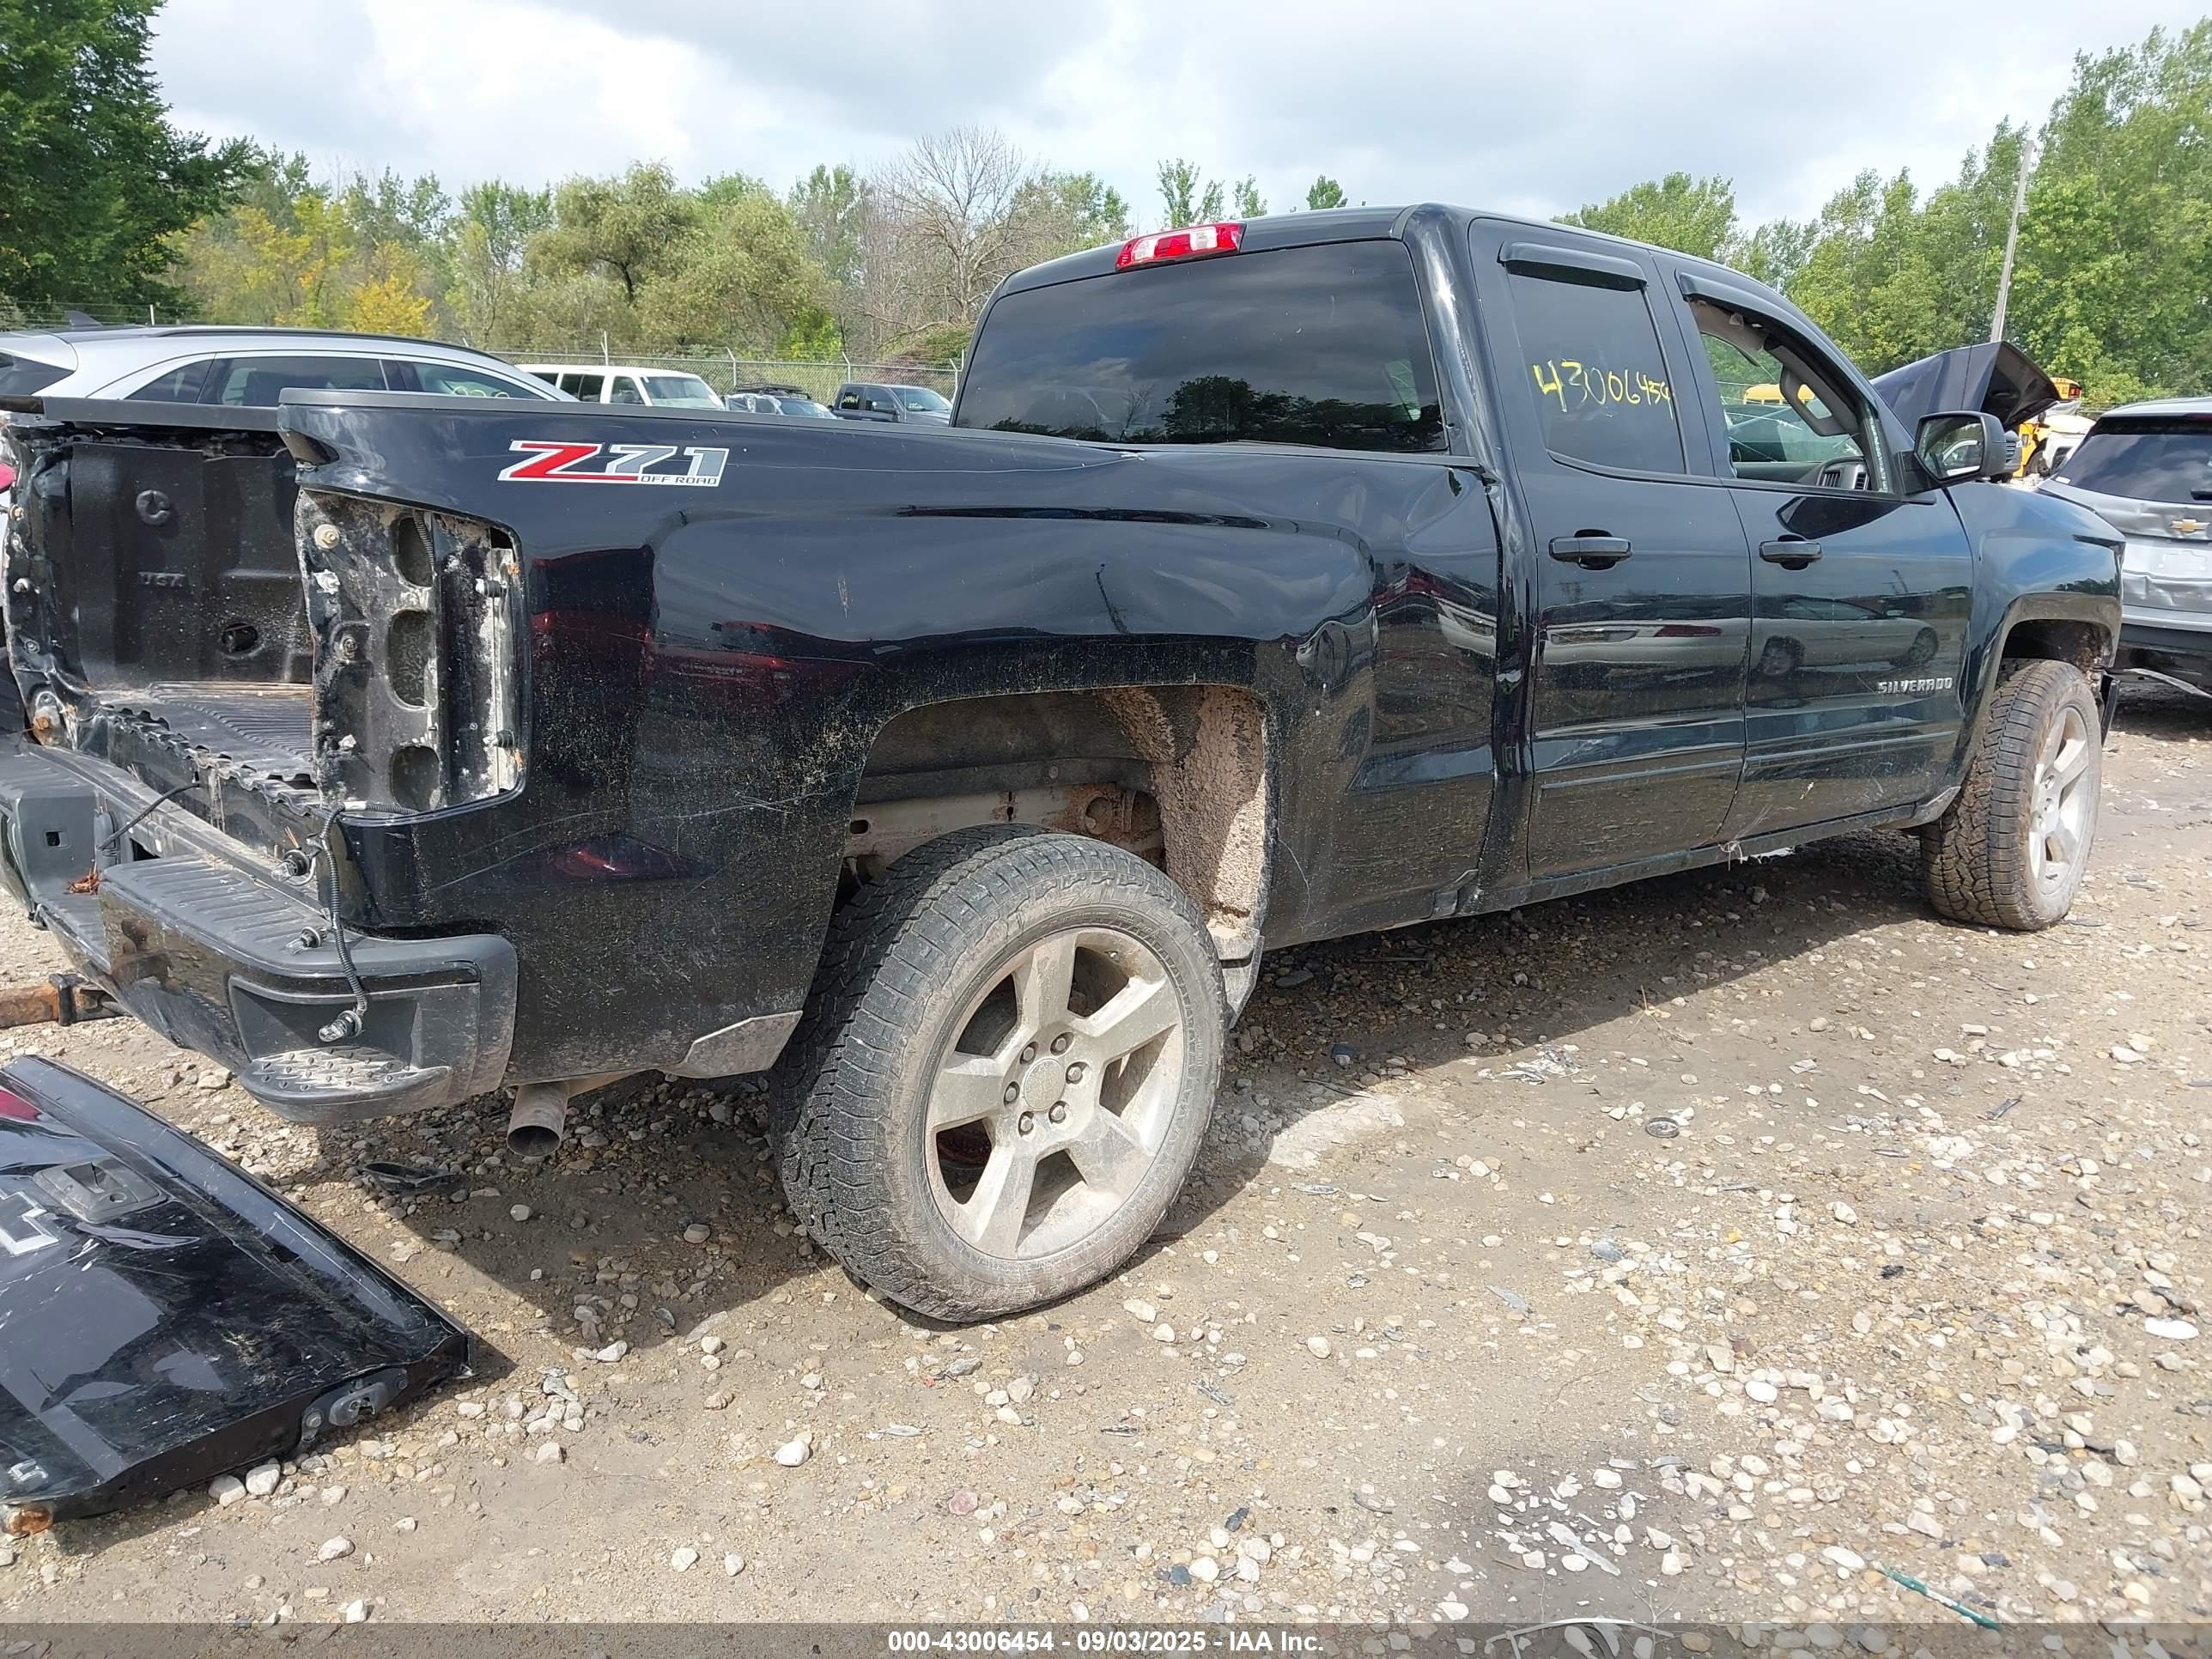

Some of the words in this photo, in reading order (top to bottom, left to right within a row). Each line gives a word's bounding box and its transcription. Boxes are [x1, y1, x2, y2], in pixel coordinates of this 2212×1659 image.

[1532, 358, 1674, 420] 43006454
[496, 439, 730, 487] Z71
[640, 475, 672, 484] OFF
[674, 477, 718, 486] ROAD
[1877, 677, 1954, 696] SILVERADO
